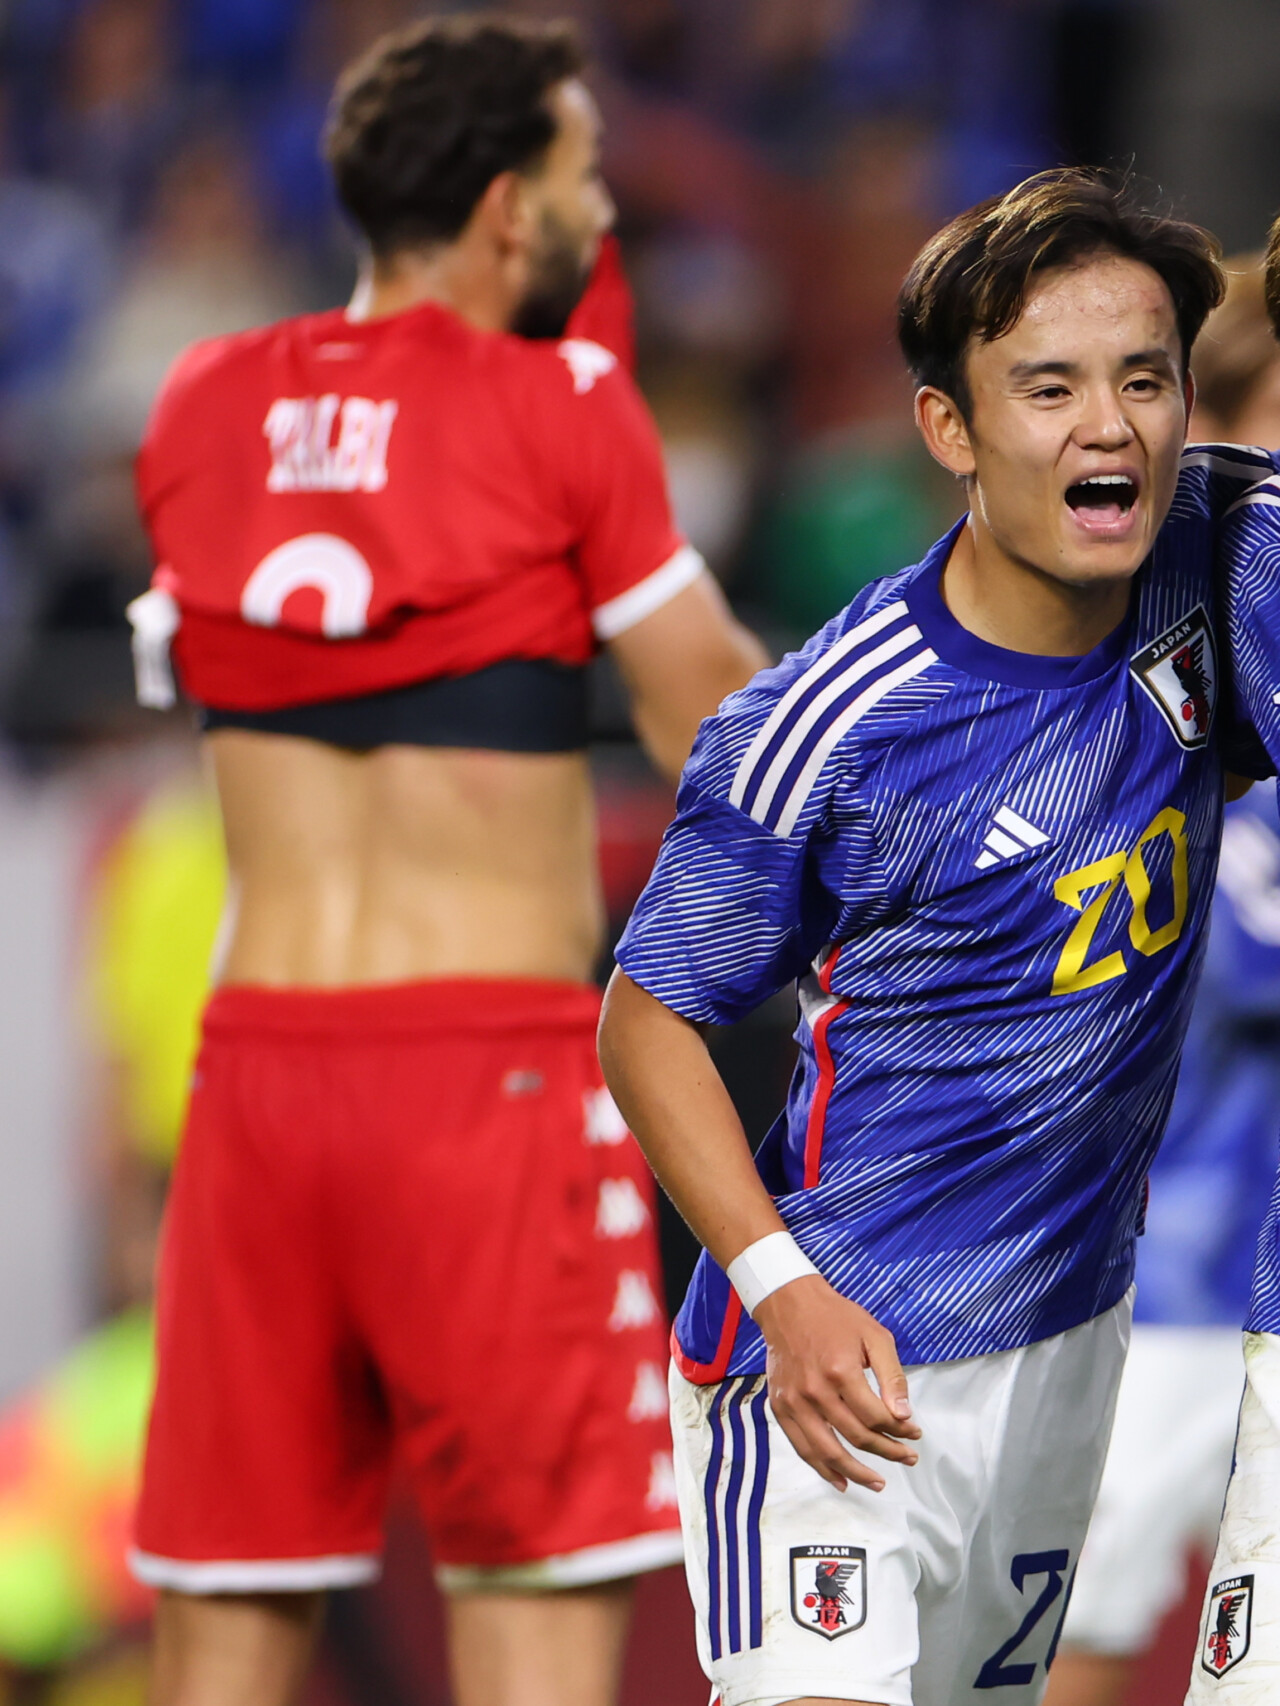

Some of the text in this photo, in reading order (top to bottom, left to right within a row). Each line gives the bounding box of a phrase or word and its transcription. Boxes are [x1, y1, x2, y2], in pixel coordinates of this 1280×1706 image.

[1151, 623, 1192, 660] JAPAN
[1050, 806, 1189, 996] 20
[806, 1546, 850, 1557] JAPAN
[1217, 1578, 1242, 1594] JAPAN
[811, 1608, 848, 1625] JFA
[972, 1548, 1078, 1690] 2
